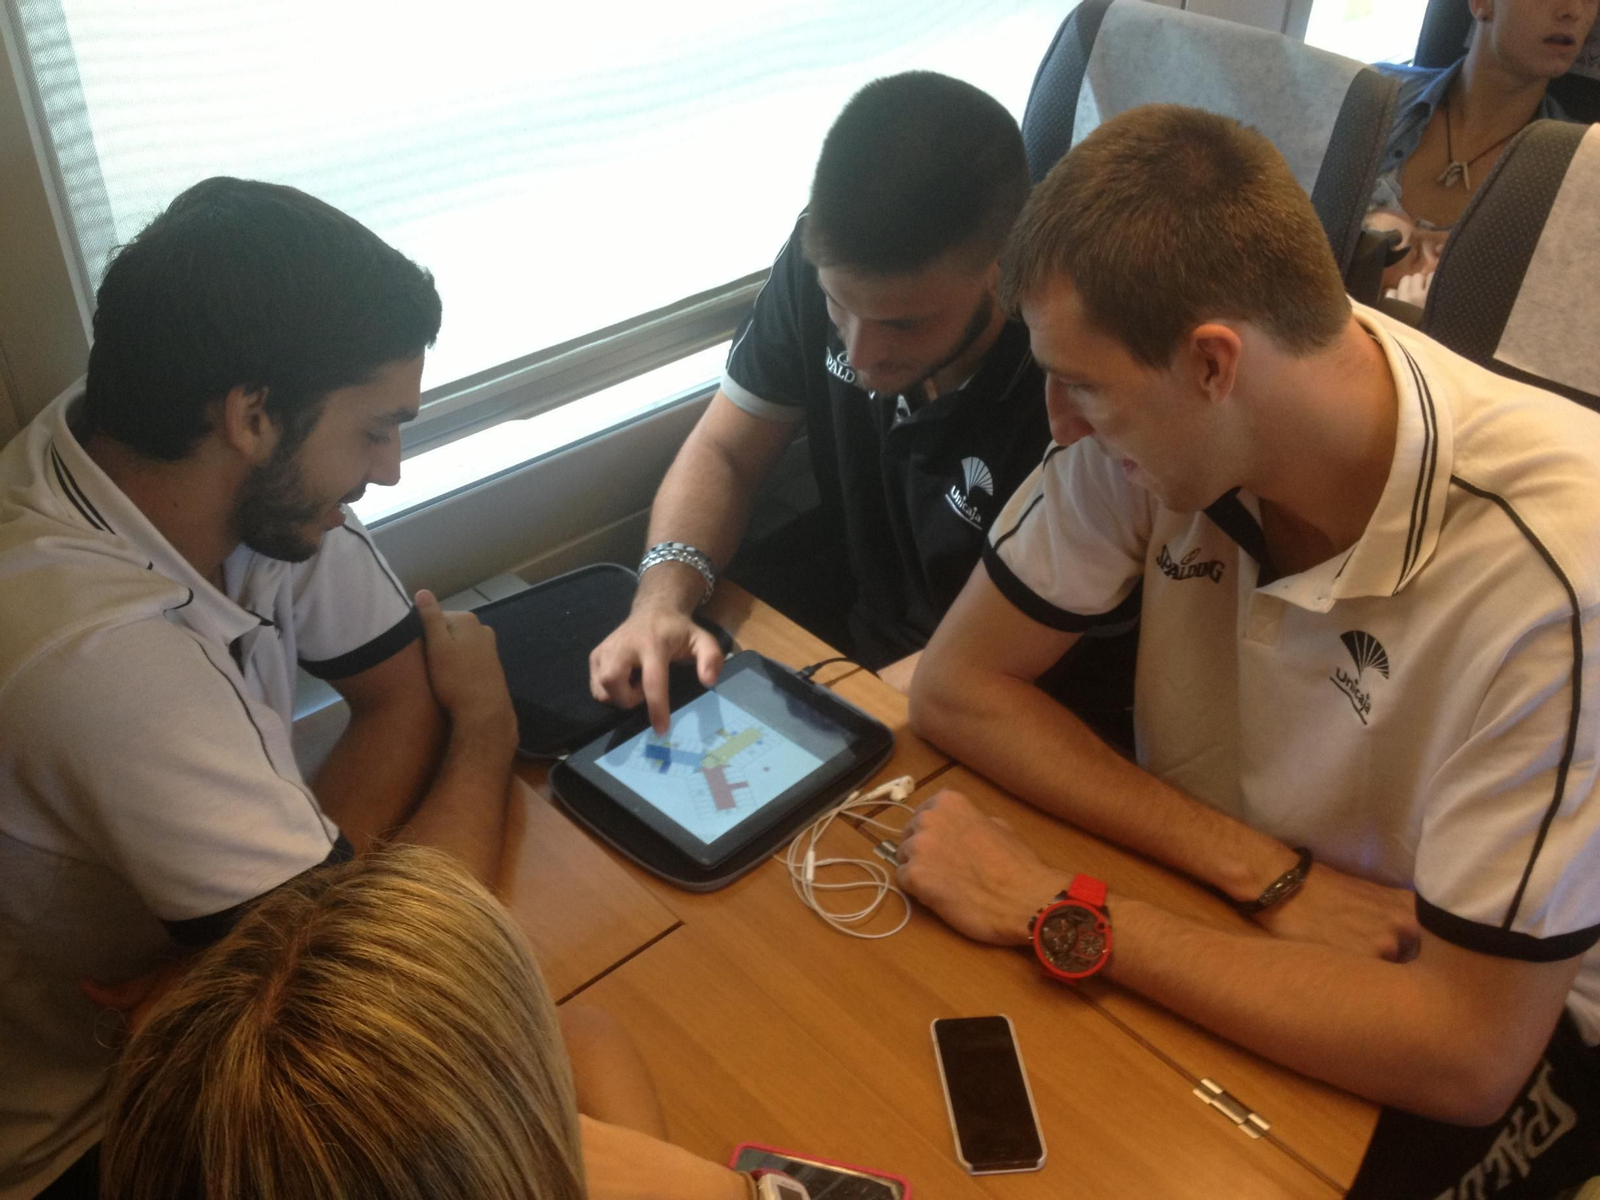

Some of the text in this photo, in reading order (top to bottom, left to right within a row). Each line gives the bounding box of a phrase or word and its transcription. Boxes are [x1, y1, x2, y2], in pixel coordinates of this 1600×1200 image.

[949, 484, 982, 523] Unicaja
[1156, 544, 1225, 584] SPALDING
[1335, 666, 1372, 716] Unicaja
